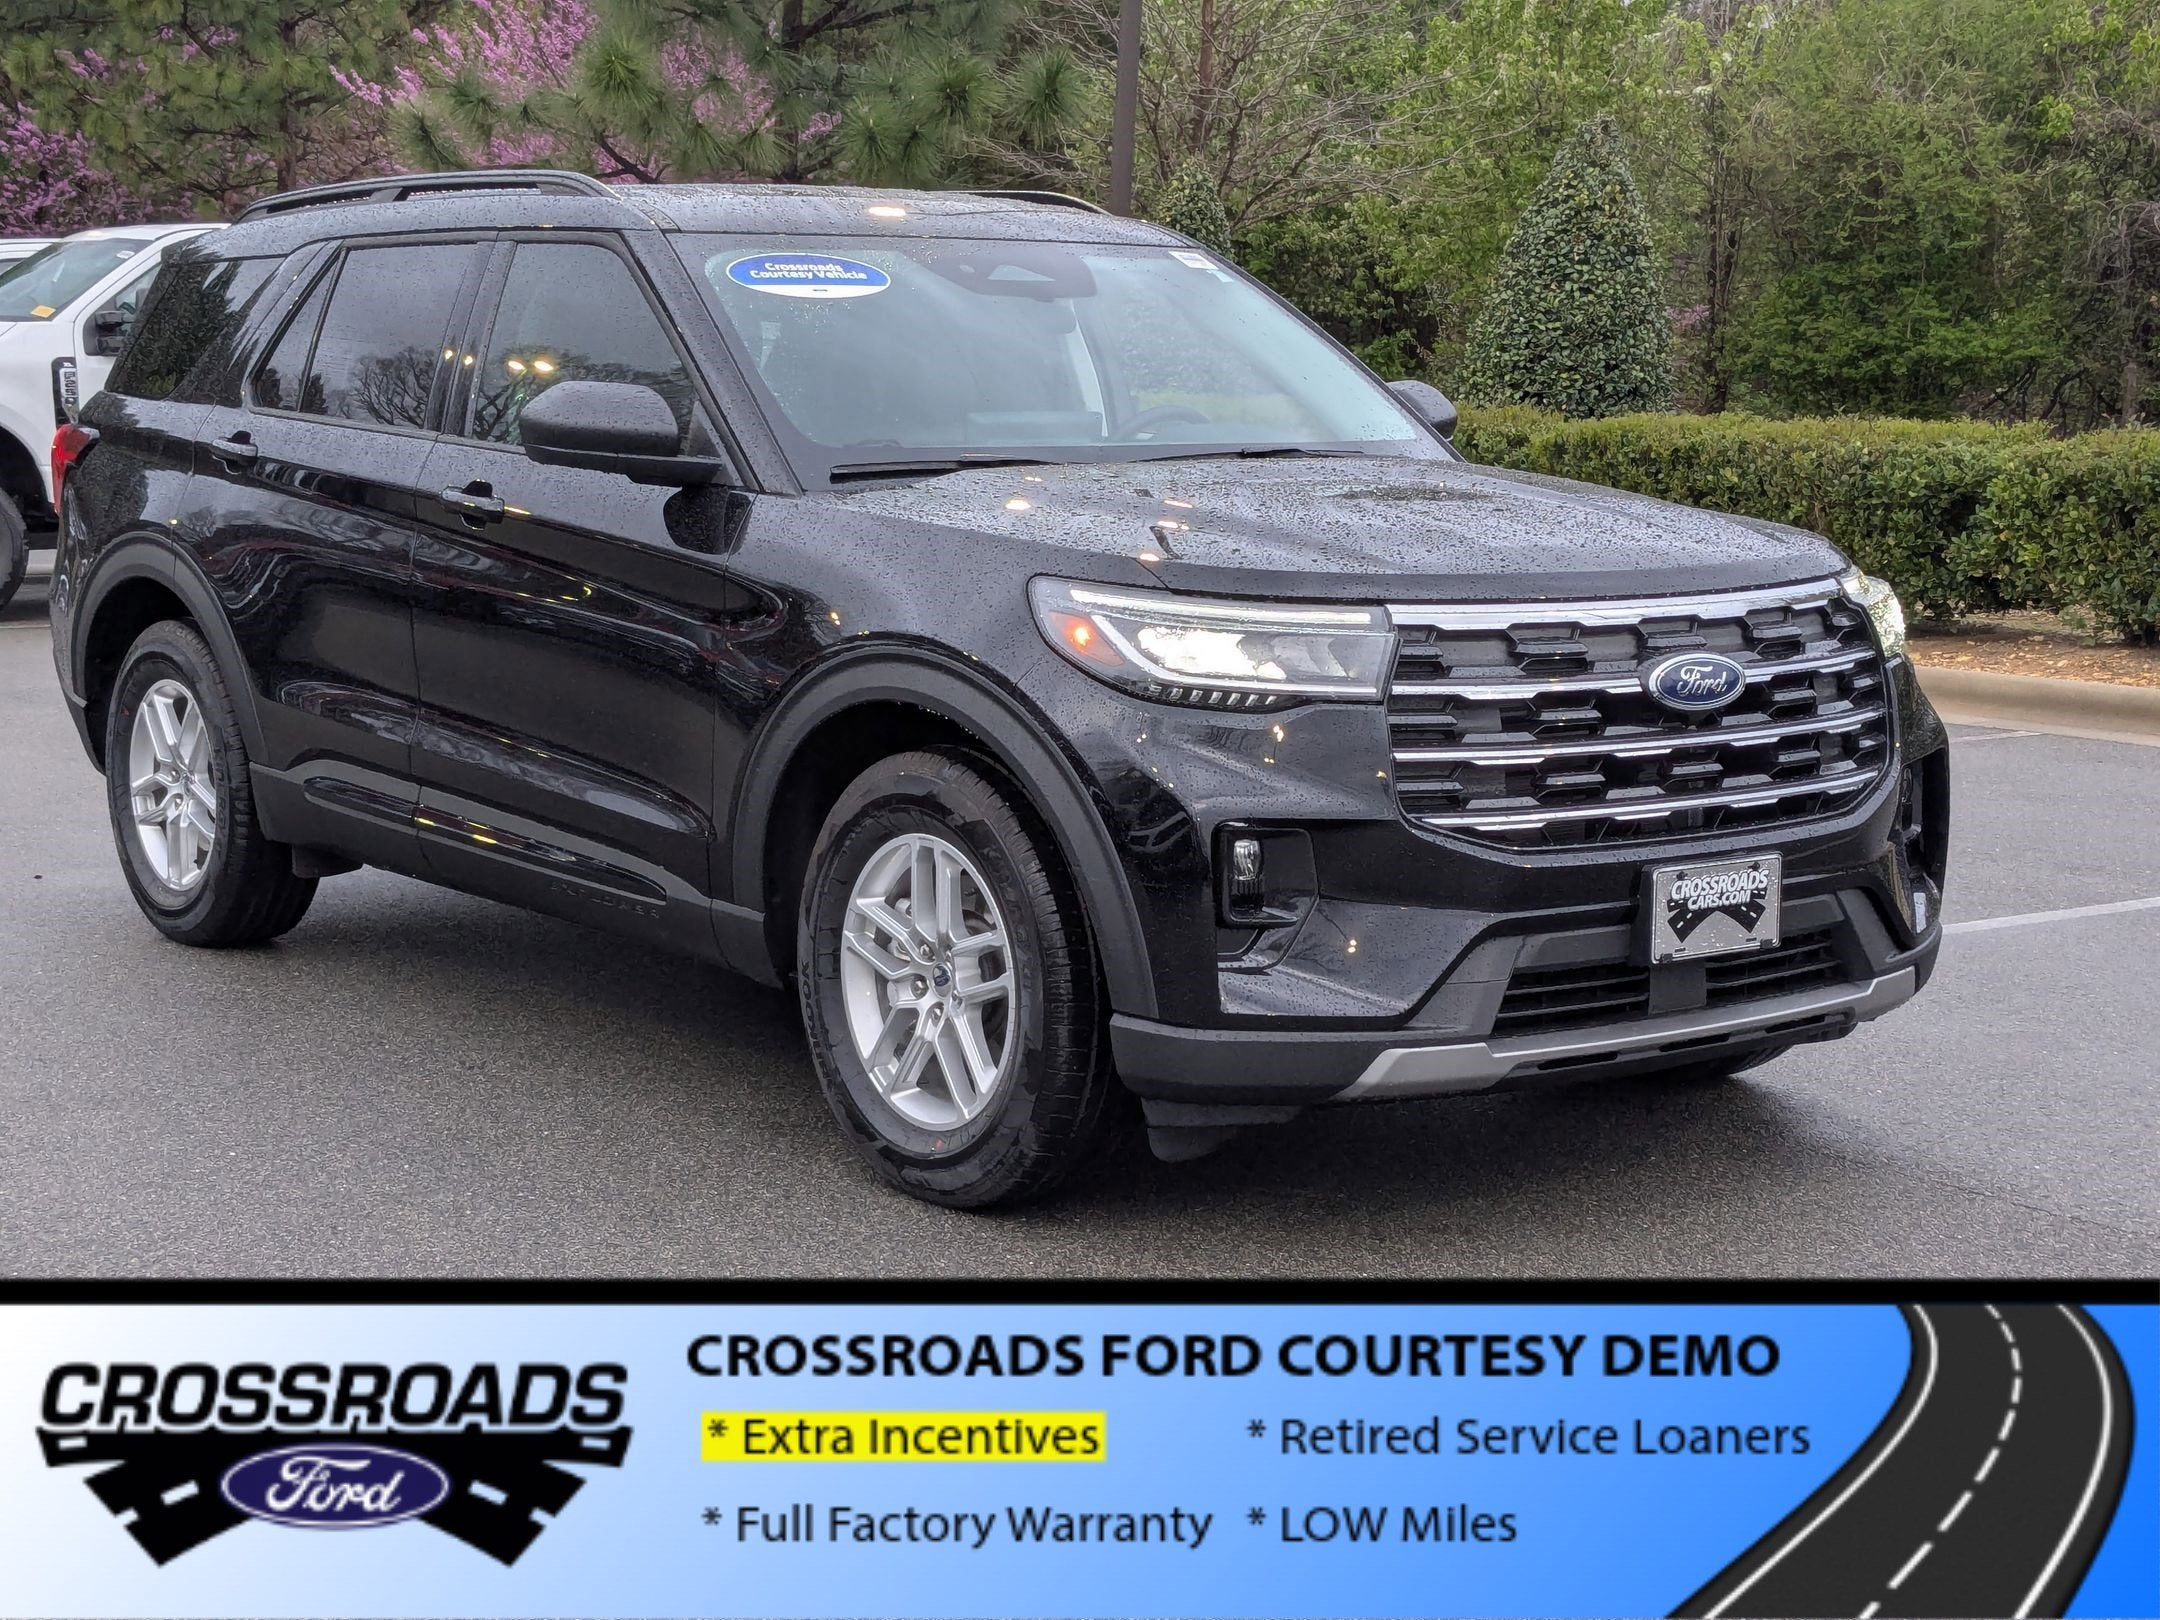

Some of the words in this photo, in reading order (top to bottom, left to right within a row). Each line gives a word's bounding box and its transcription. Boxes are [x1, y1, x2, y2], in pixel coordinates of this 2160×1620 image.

[749, 269, 814, 280] Courtesy
[814, 269, 868, 281] Vehicle
[763, 262, 844, 273] Crossroads
[1676, 665, 1728, 697] Ford
[1670, 868, 1770, 900] CROSSROADS
[1686, 888, 1752, 912] CARS.COM
